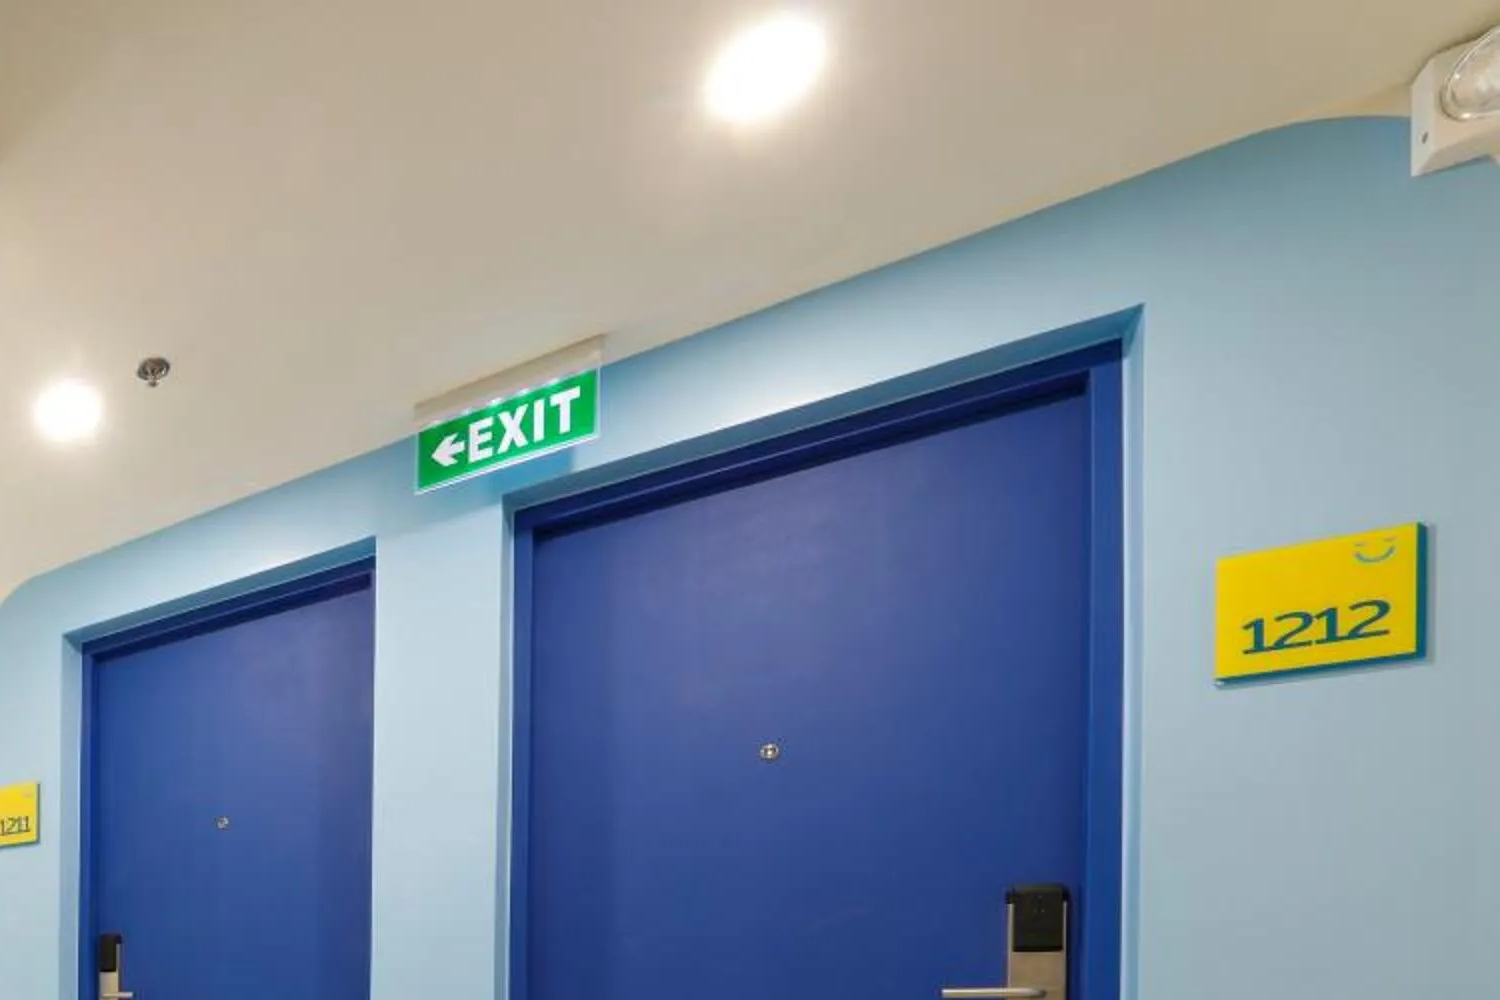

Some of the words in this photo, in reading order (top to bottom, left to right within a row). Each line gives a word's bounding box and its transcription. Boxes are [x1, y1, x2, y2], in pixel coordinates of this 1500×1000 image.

[468, 386, 581, 463] EXIT
[1242, 599, 1391, 655] 1212
[0, 815, 31, 837] 1211
